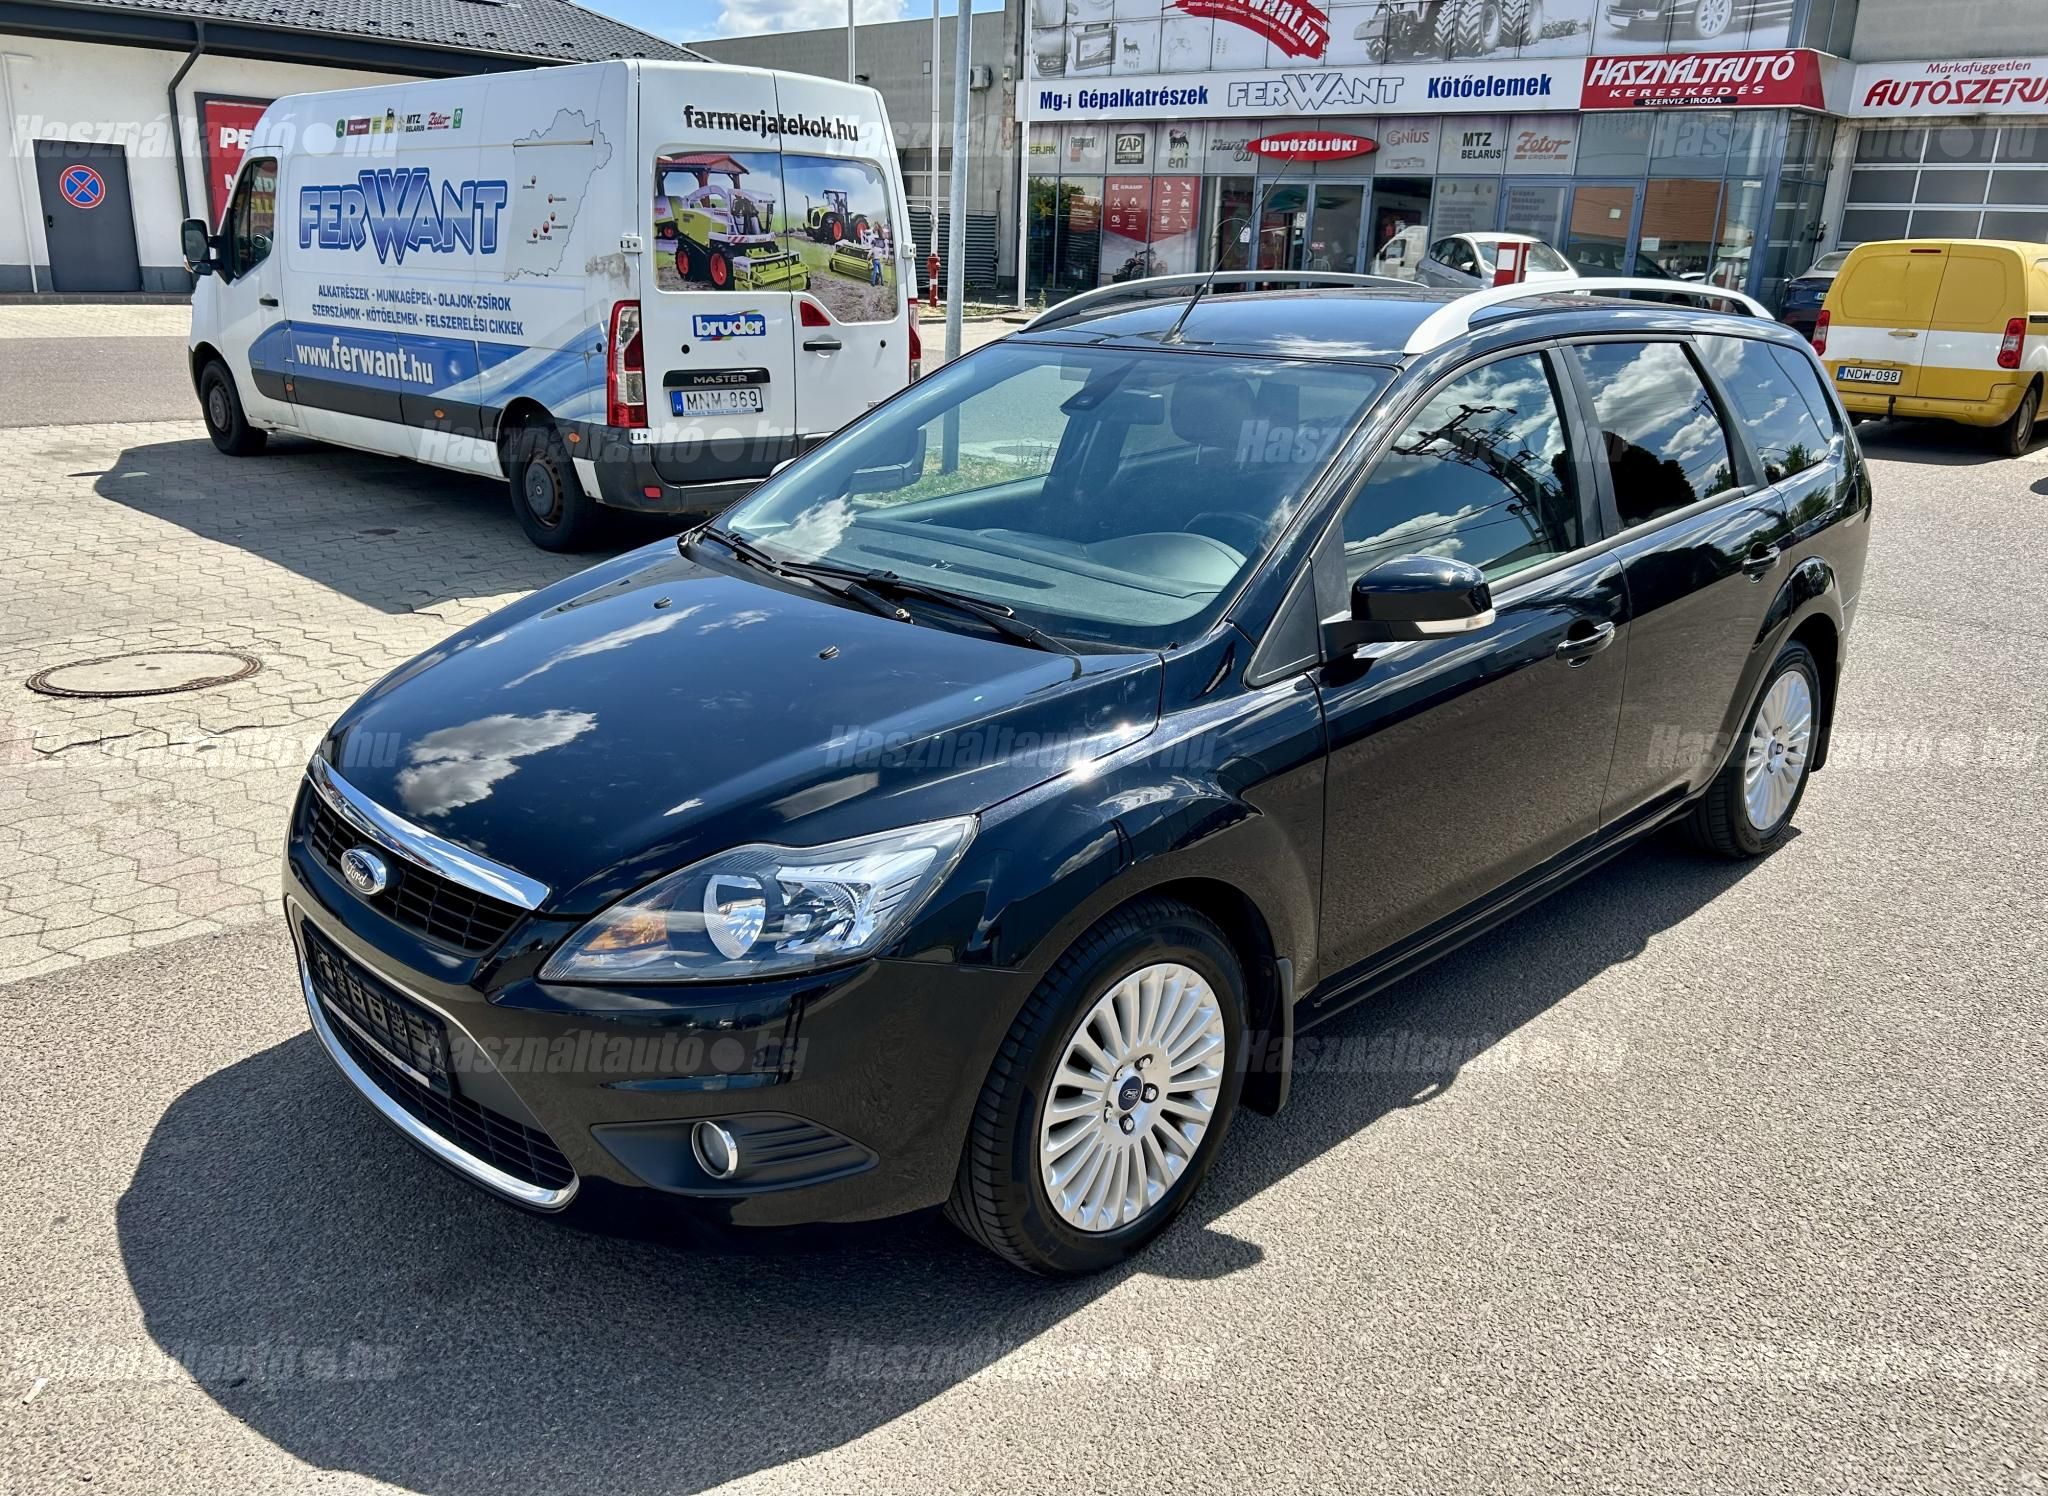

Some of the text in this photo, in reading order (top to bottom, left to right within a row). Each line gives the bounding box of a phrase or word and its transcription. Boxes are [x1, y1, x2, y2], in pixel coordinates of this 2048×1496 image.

[1587, 51, 1796, 86] HASZNÁLTAUTÓ
[1926, 60, 2031, 75] Márkafüggetlen
[1228, 72, 1404, 111] FERWANT
[1427, 73, 1552, 98] Kötőelemek
[1609, 85, 1766, 97] KERESKEDÉS
[1863, 75, 2048, 108] AUTÓSZERV
[1040, 85, 1208, 111] Mg-i Gépalkatrészek
[406, 114, 421, 124] MTZ
[683, 104, 859, 142] farmerjatekok.hu
[1118, 137, 1141, 151] ZAP
[1260, 138, 1358, 152] ÜDVÖZÖLJÜK!
[1462, 132, 1492, 147] MTZ
[1516, 131, 1571, 153] Zetor
[1168, 153, 1189, 168] eni
[1461, 150, 1502, 160] BELARUS
[300, 167, 508, 265] FERWANT
[318, 284, 369, 301] ALKATRÉSZEK
[376, 288, 432, 306] MUNKAGÉPEK
[312, 303, 361, 320] SZERSZÁMOK
[425, 314, 488, 333] FELSZERELÉSI
[489, 320, 524, 336] CIKKEK
[695, 315, 763, 336] bruder
[296, 336, 434, 385] www.ferwant.hu
[693, 374, 748, 384] MASTER
[1846, 368, 1898, 381] NDW-098
[686, 390, 757, 411] MNM-869
